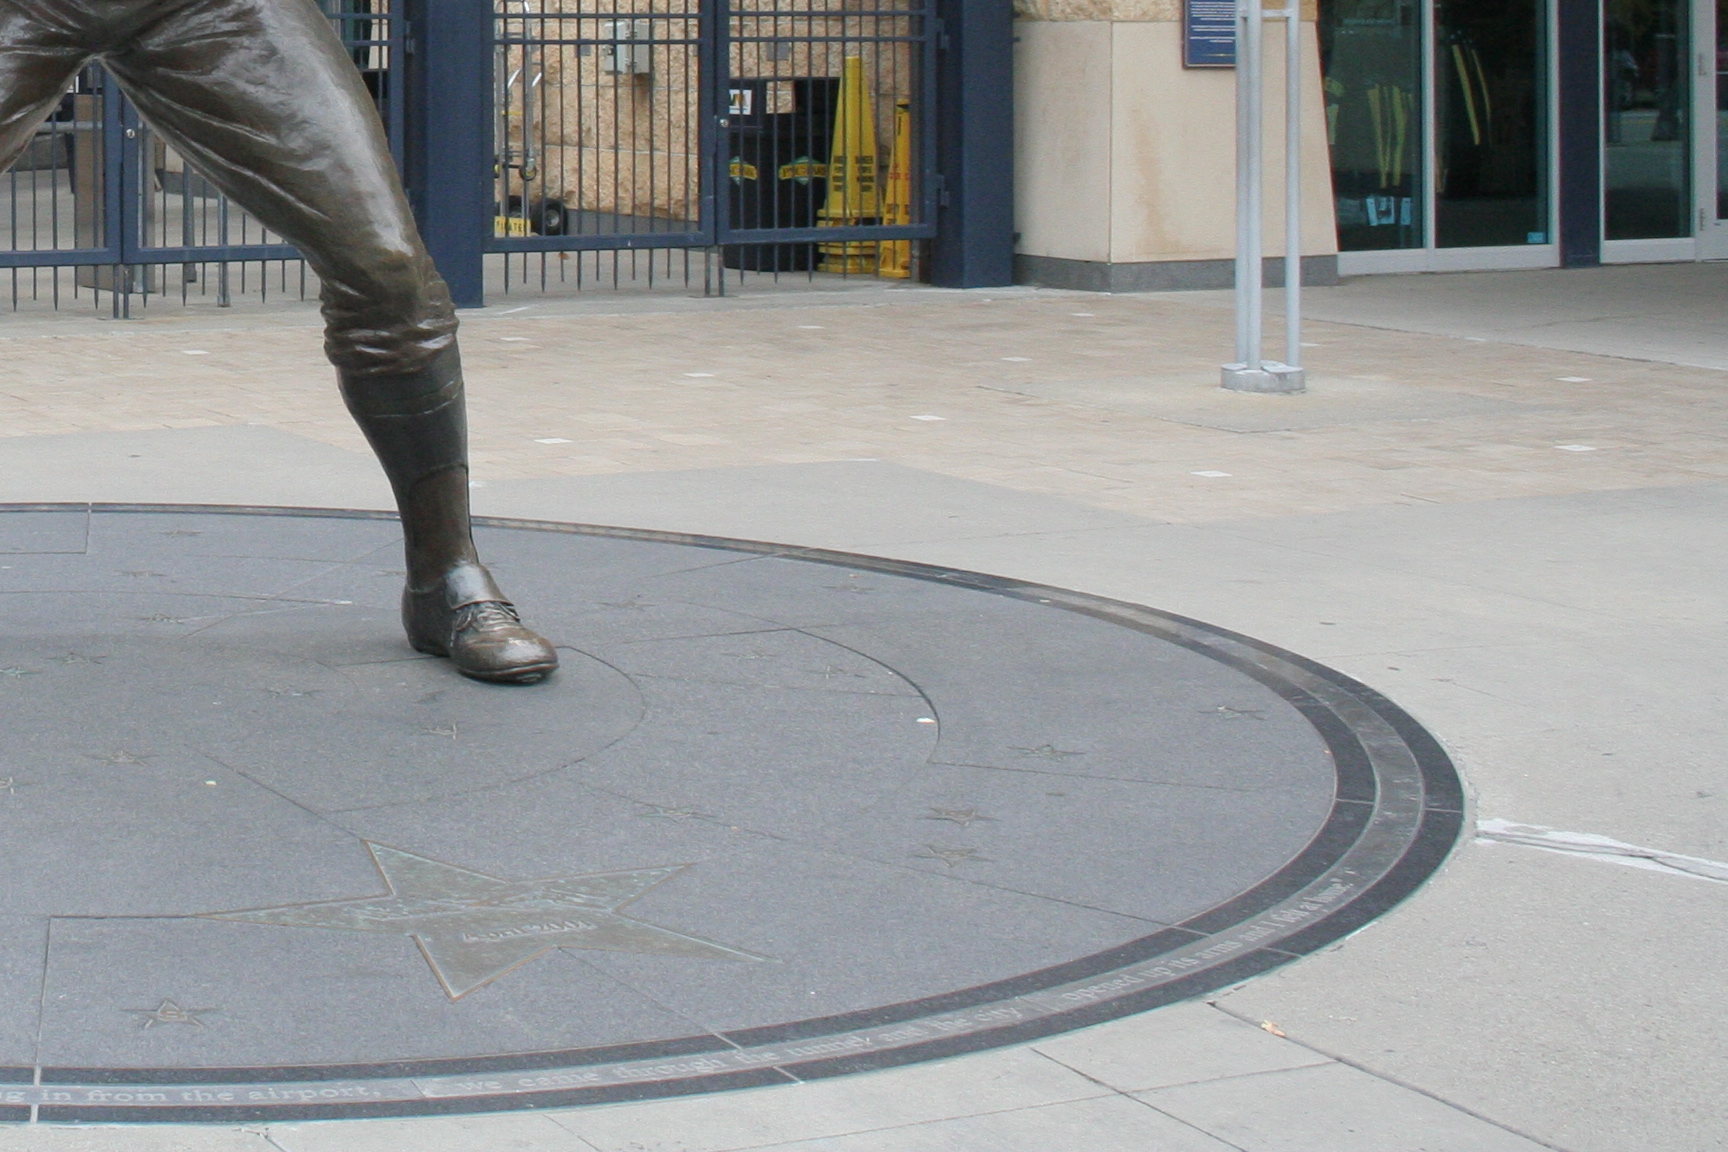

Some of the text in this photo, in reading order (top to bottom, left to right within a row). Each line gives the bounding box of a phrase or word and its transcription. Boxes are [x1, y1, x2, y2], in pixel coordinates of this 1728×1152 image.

[42, 1087, 72, 1102] in
[87, 1088, 167, 1102] from
[181, 1088, 234, 1102] the
[249, 1085, 382, 1103] airport,
[458, 1079, 503, 1091] we
[519, 1072, 600, 1088] came
[613, 1056, 727, 1079] through
[735, 1050, 780, 1065] the
[975, 1007, 1023, 1022] city
[1062, 974, 1145, 1000] opened
[1140, 965, 1175, 978] up
